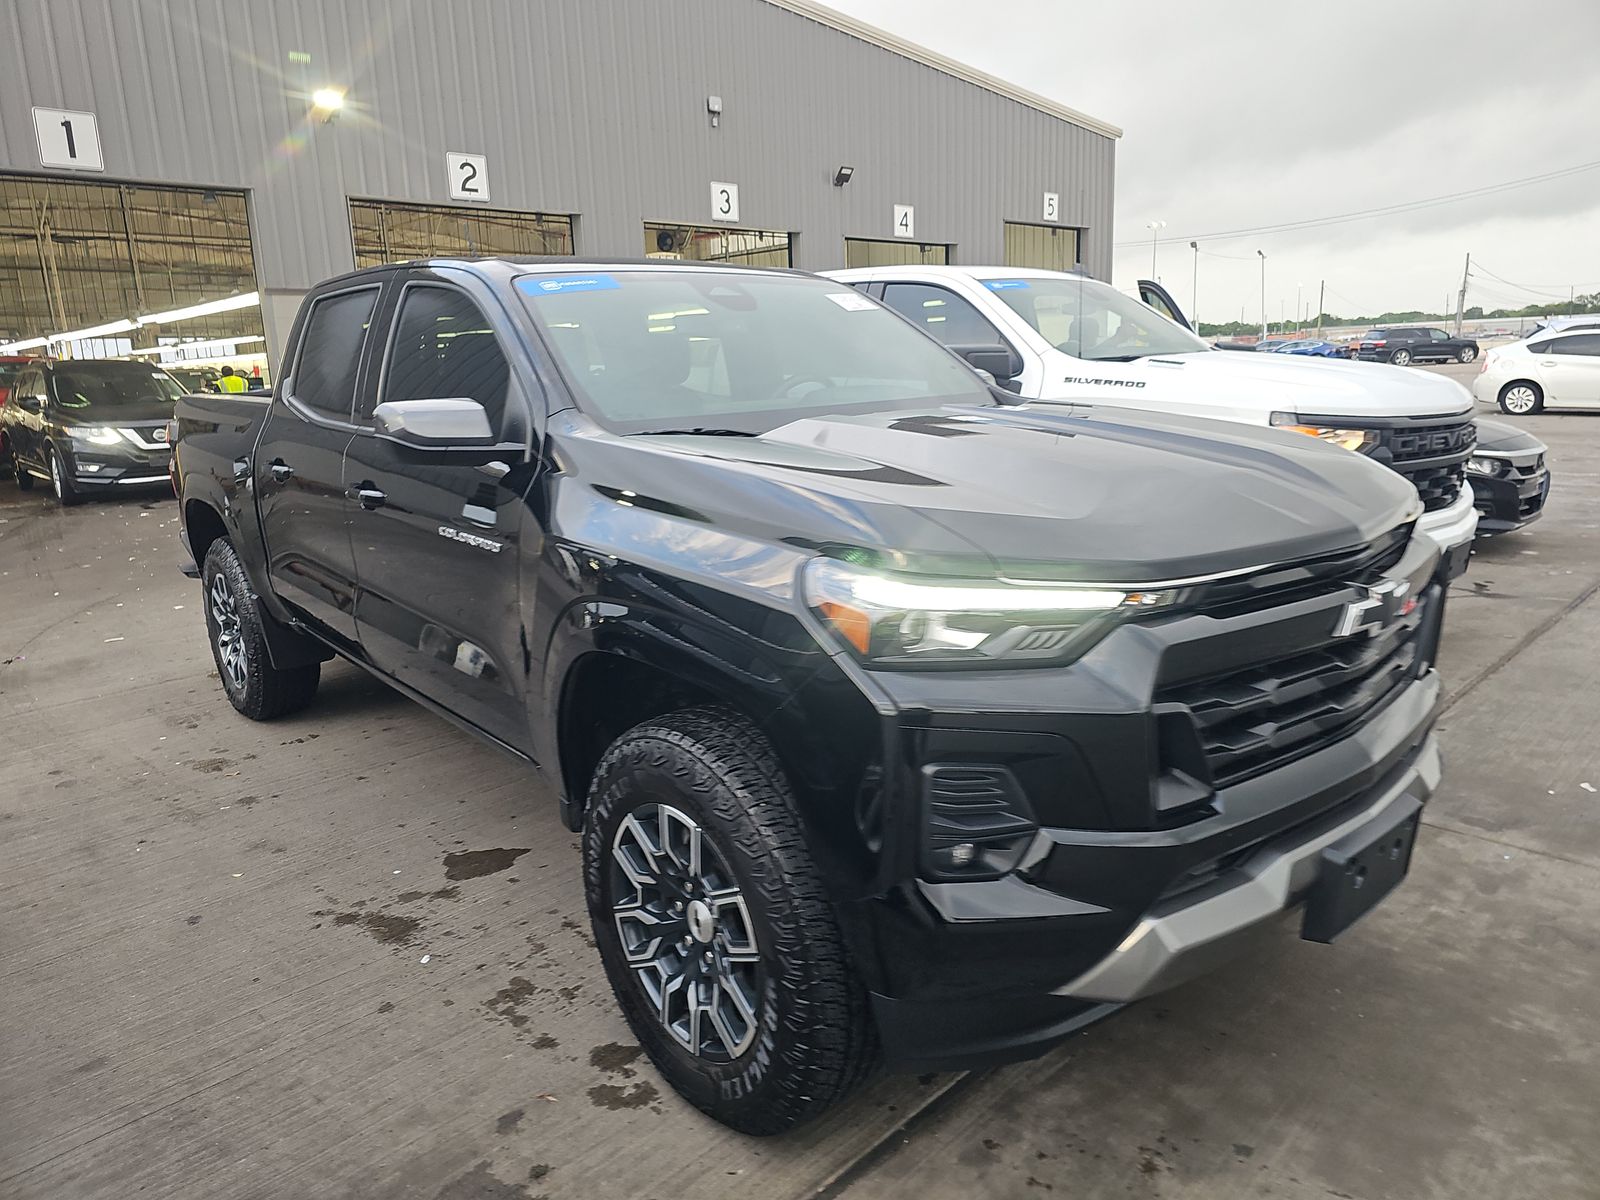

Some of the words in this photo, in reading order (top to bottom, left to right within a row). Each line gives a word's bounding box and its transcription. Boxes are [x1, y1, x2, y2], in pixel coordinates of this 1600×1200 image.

[60, 120, 77, 159] 1
[459, 162, 479, 193] 2
[719, 189, 731, 214] 3
[1047, 197, 1055, 216] 5
[899, 211, 909, 232] 4
[1064, 376, 1146, 388] SILVERADO
